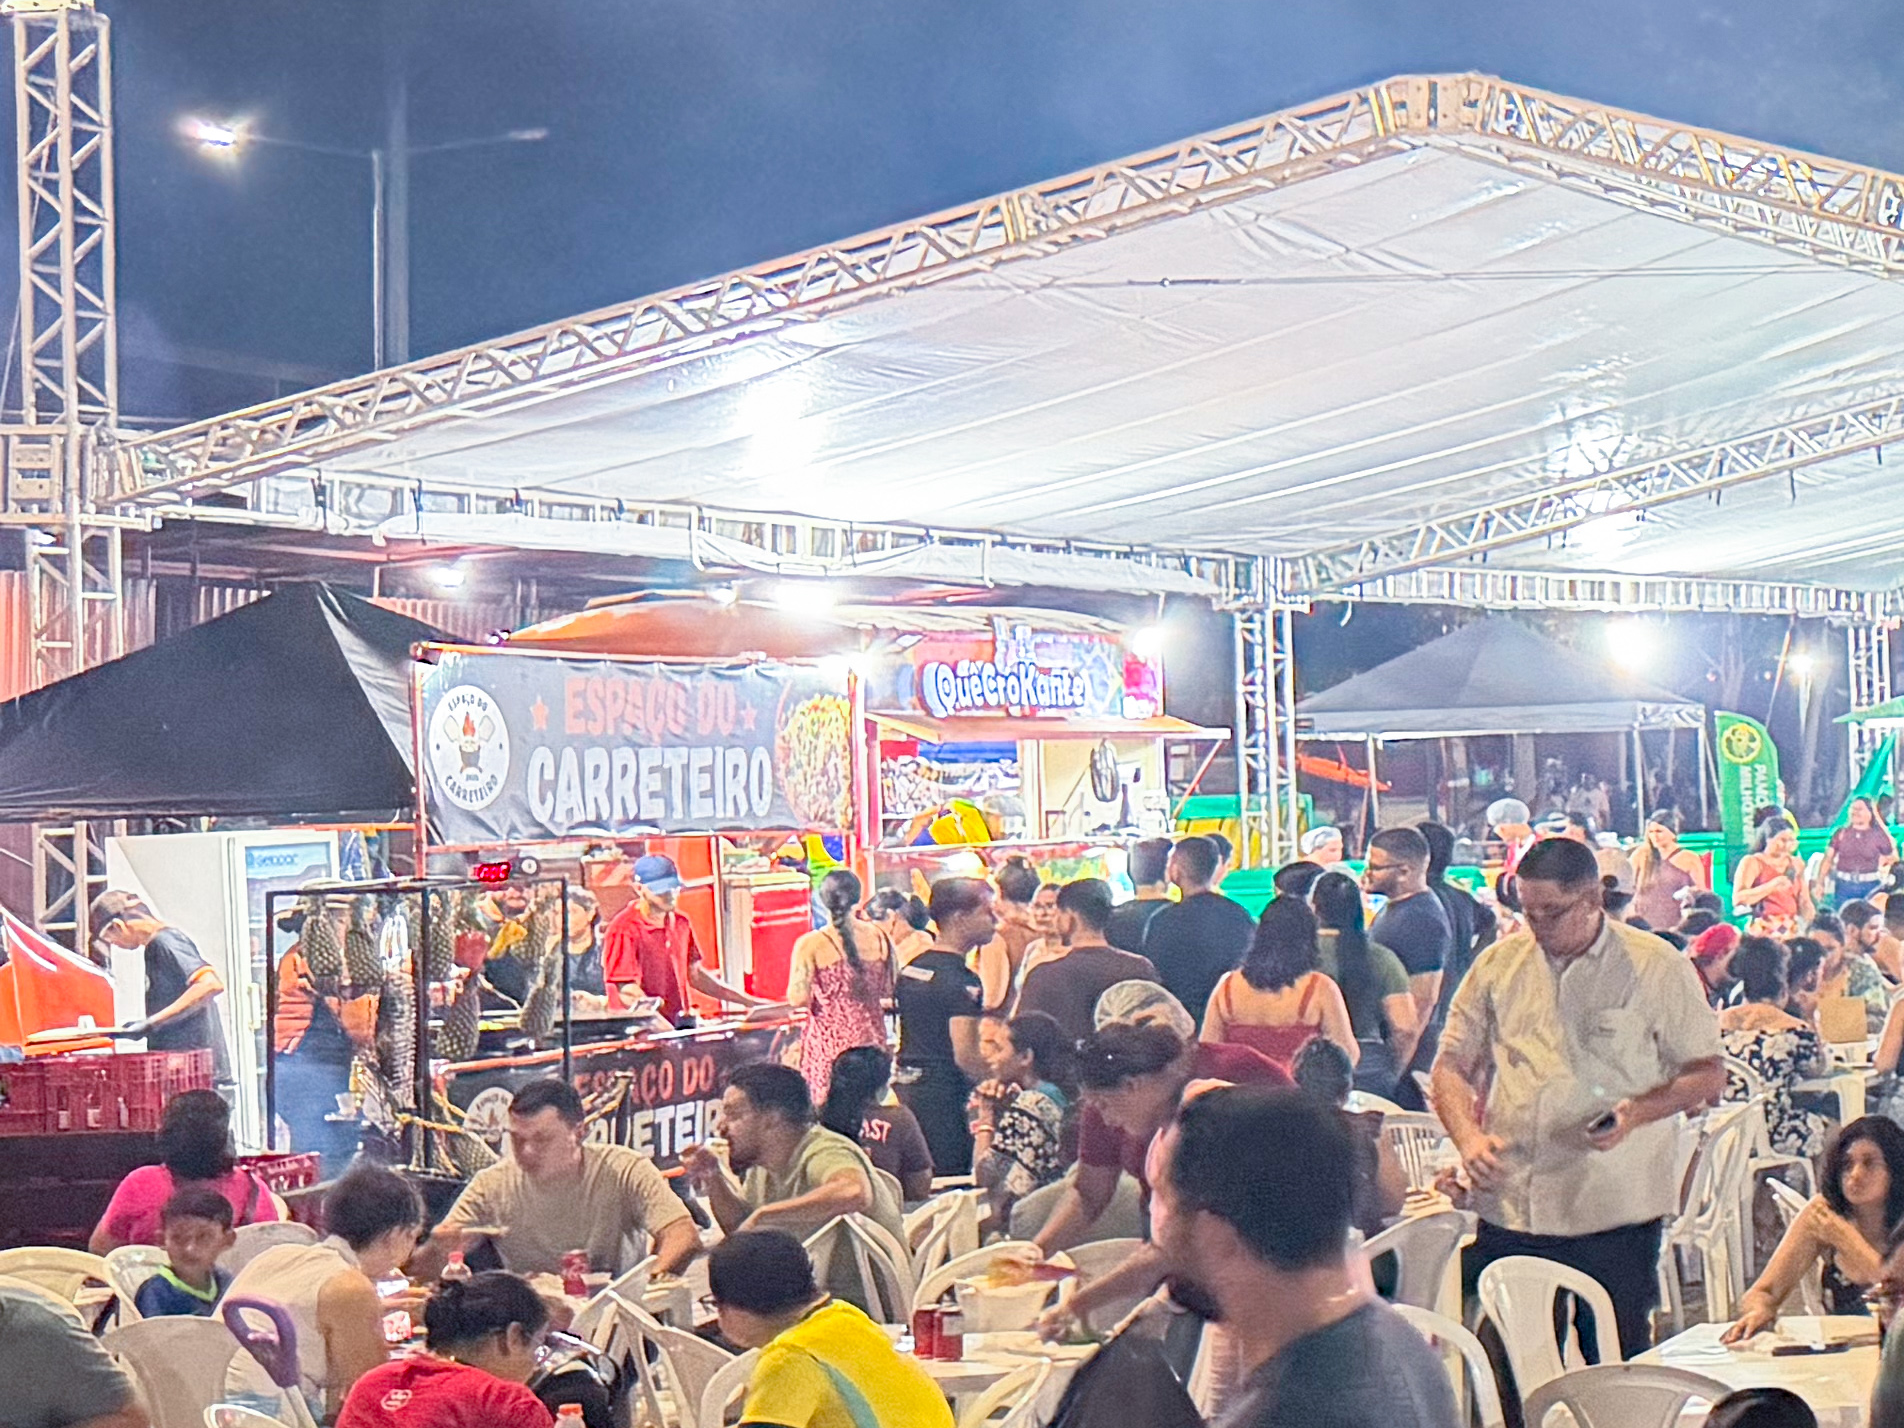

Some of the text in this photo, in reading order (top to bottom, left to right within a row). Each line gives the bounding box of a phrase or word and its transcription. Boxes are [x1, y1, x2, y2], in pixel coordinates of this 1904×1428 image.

[565, 677, 735, 744] ESPAÇO DO
[528, 744, 773, 825] CARRETEIRO
[682, 1054, 715, 1097] DO
